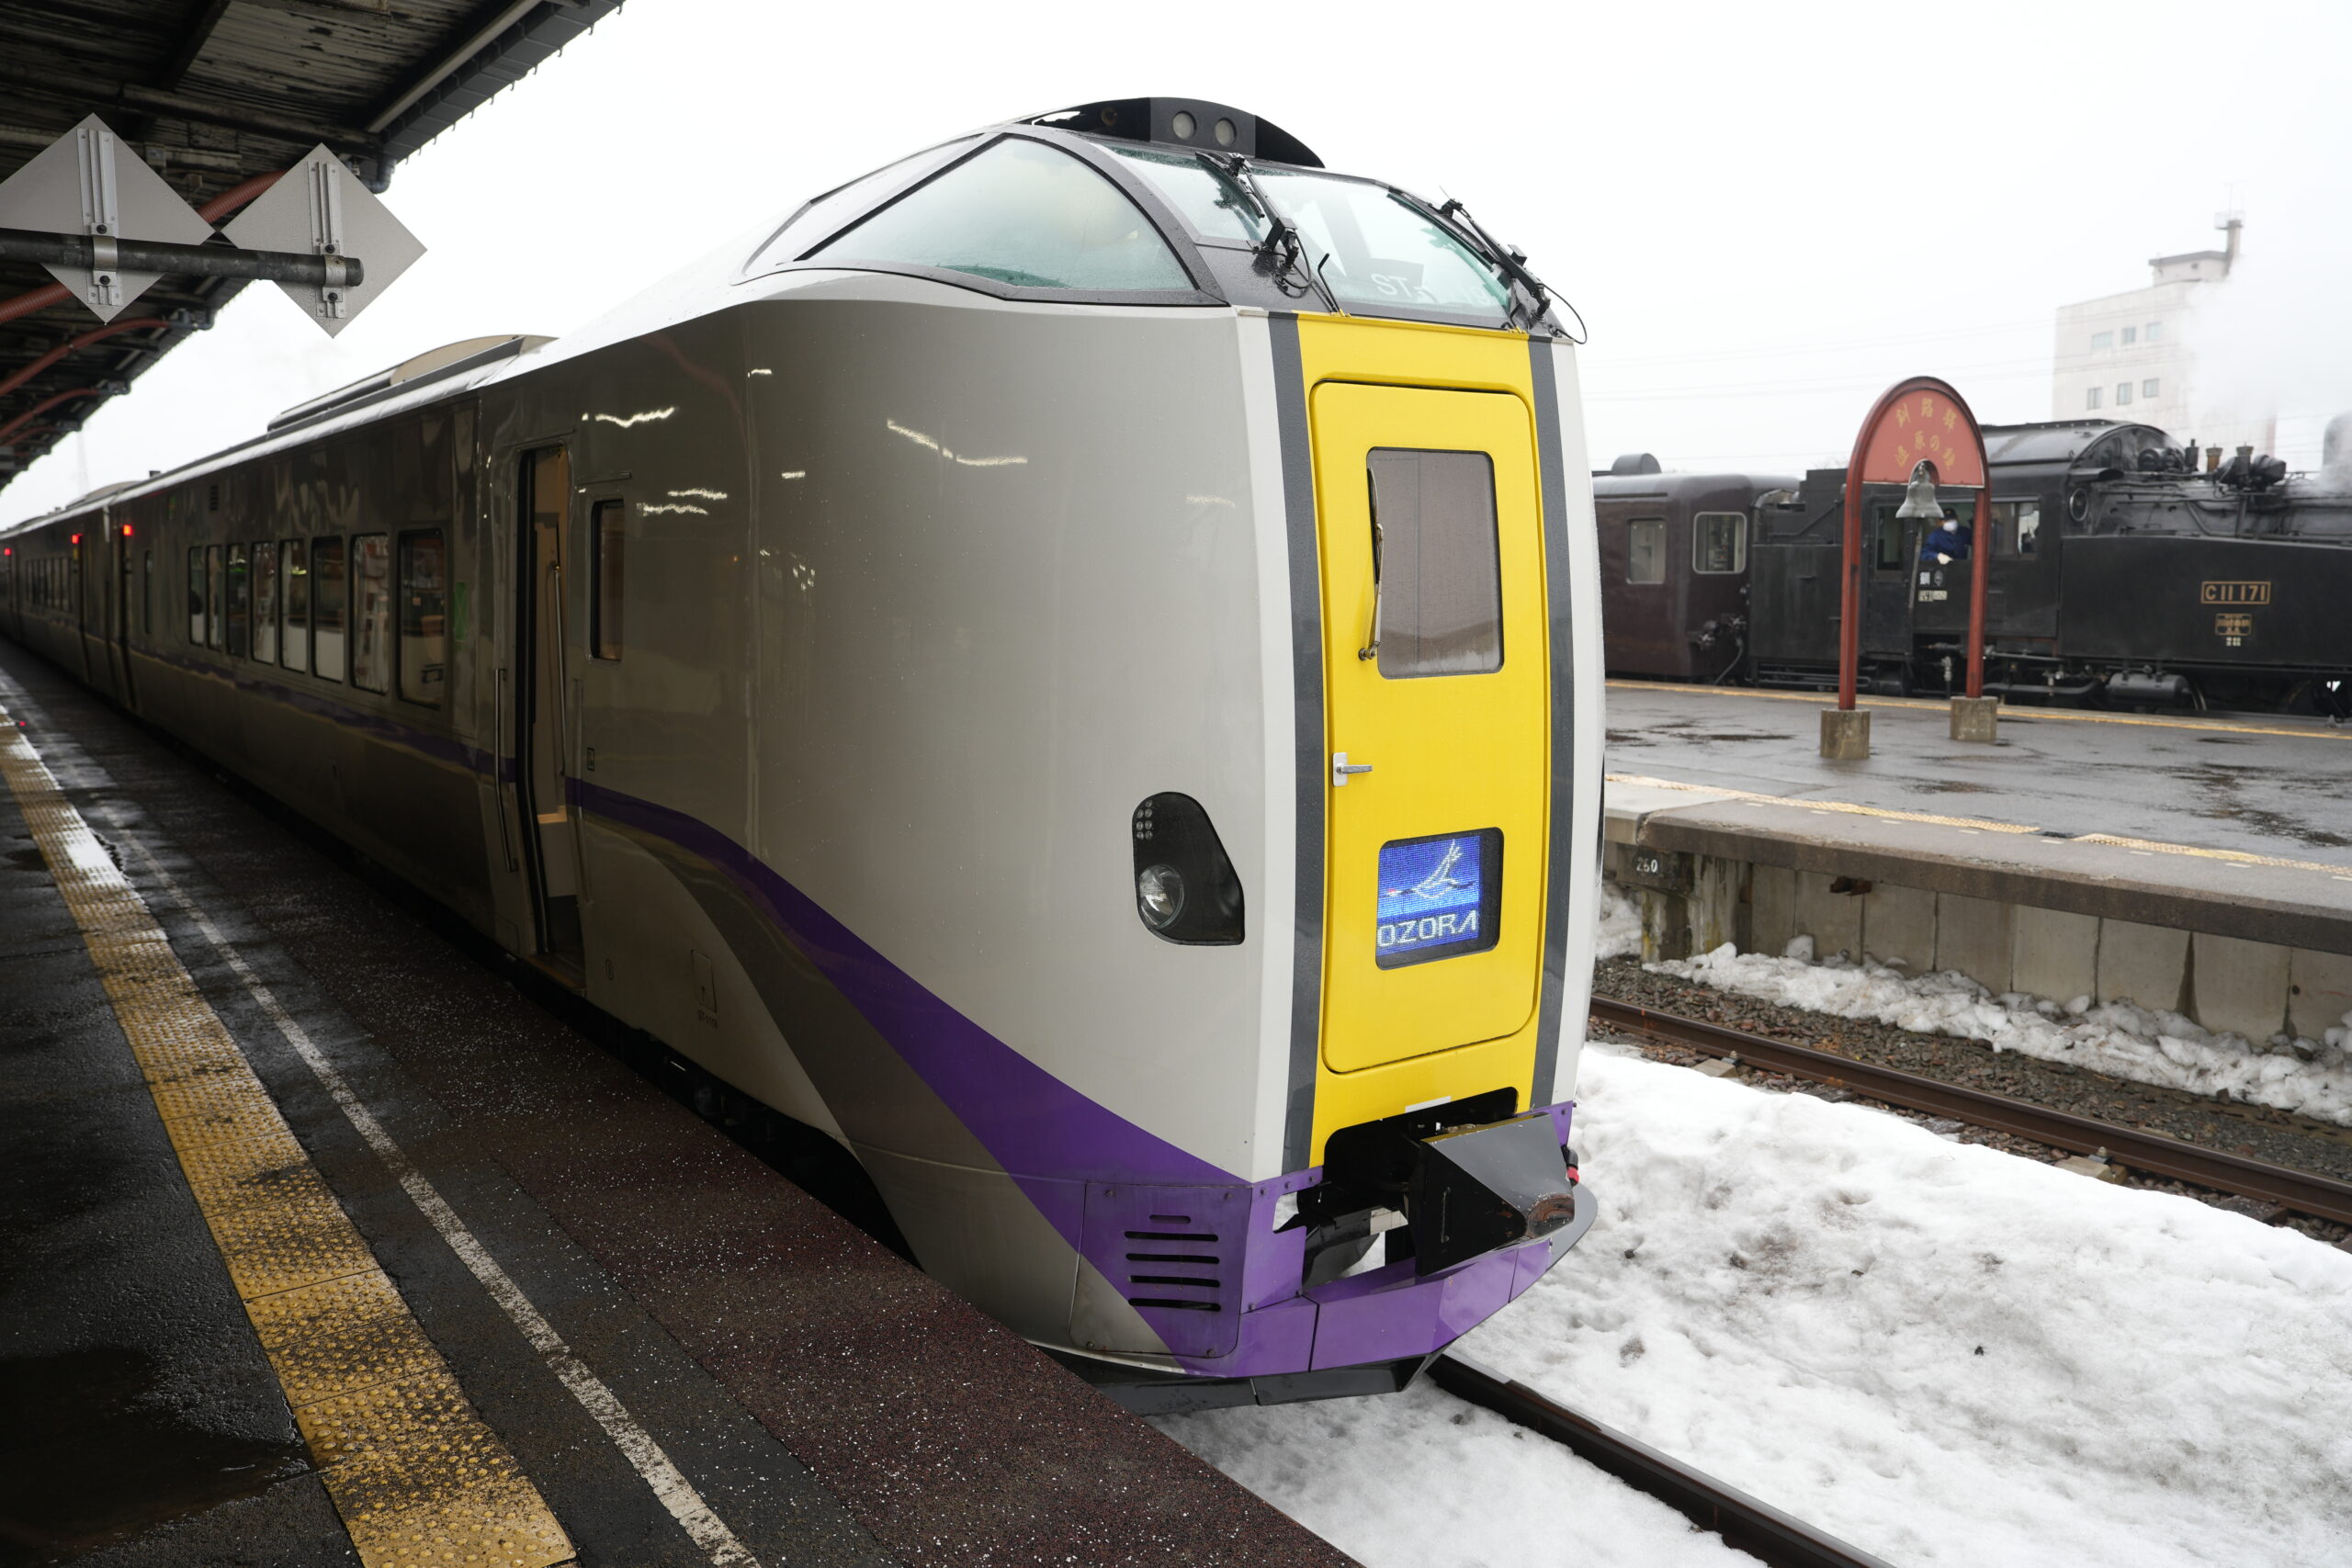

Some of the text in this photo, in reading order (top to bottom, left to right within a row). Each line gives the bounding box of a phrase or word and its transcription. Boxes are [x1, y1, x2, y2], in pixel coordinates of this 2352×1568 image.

[2205, 585, 2266, 601] C11 171
[1377, 909, 1478, 947] OZORA
